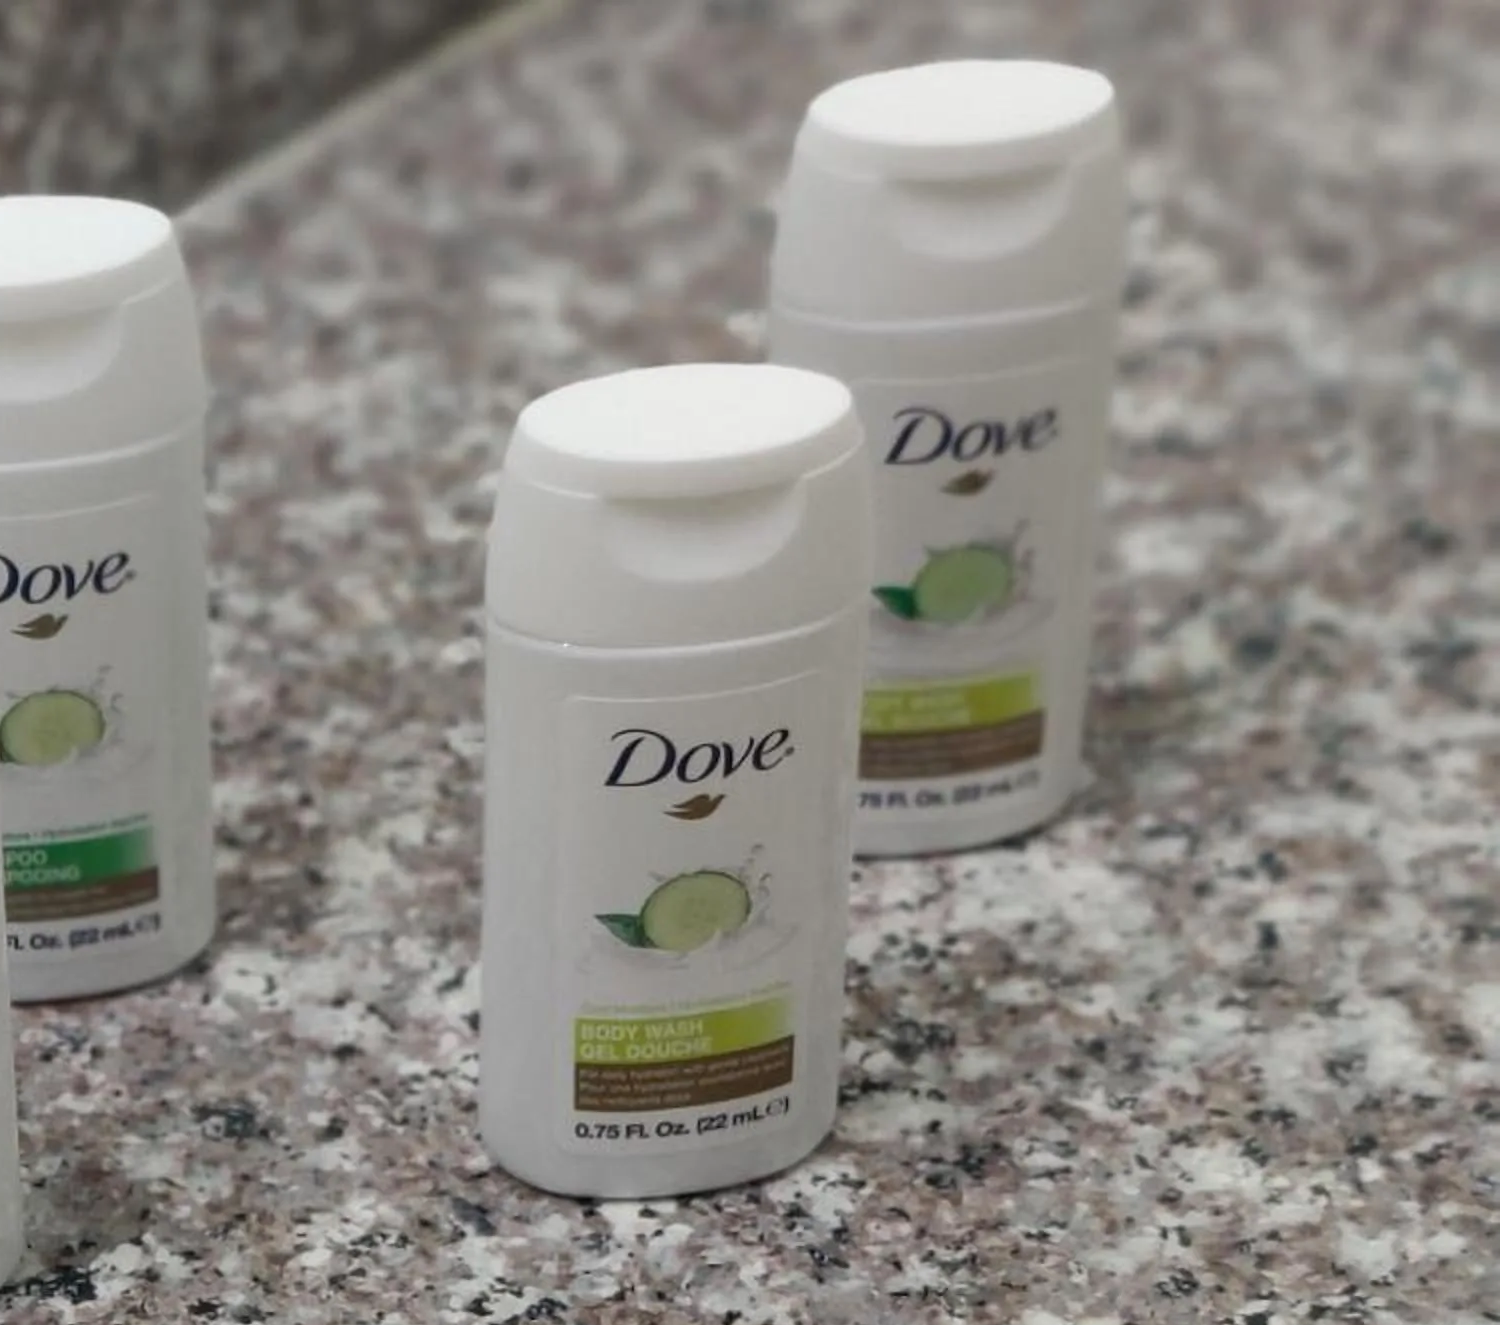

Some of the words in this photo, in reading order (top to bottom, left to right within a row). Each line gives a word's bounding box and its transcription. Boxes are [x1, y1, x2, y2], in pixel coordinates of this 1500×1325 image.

[884, 407, 1058, 464] Dove
[604, 729, 792, 787] Dove
[580, 1022, 638, 1041] BODY
[645, 1018, 703, 1039] WASH
[580, 1043, 620, 1060] GEL
[626, 1037, 712, 1060] DOUCHE
[575, 1122, 620, 1140] 0.75
[626, 1123, 649, 1139] Fl.
[655, 1120, 689, 1136] Oz.
[697, 1112, 729, 1135] (22
